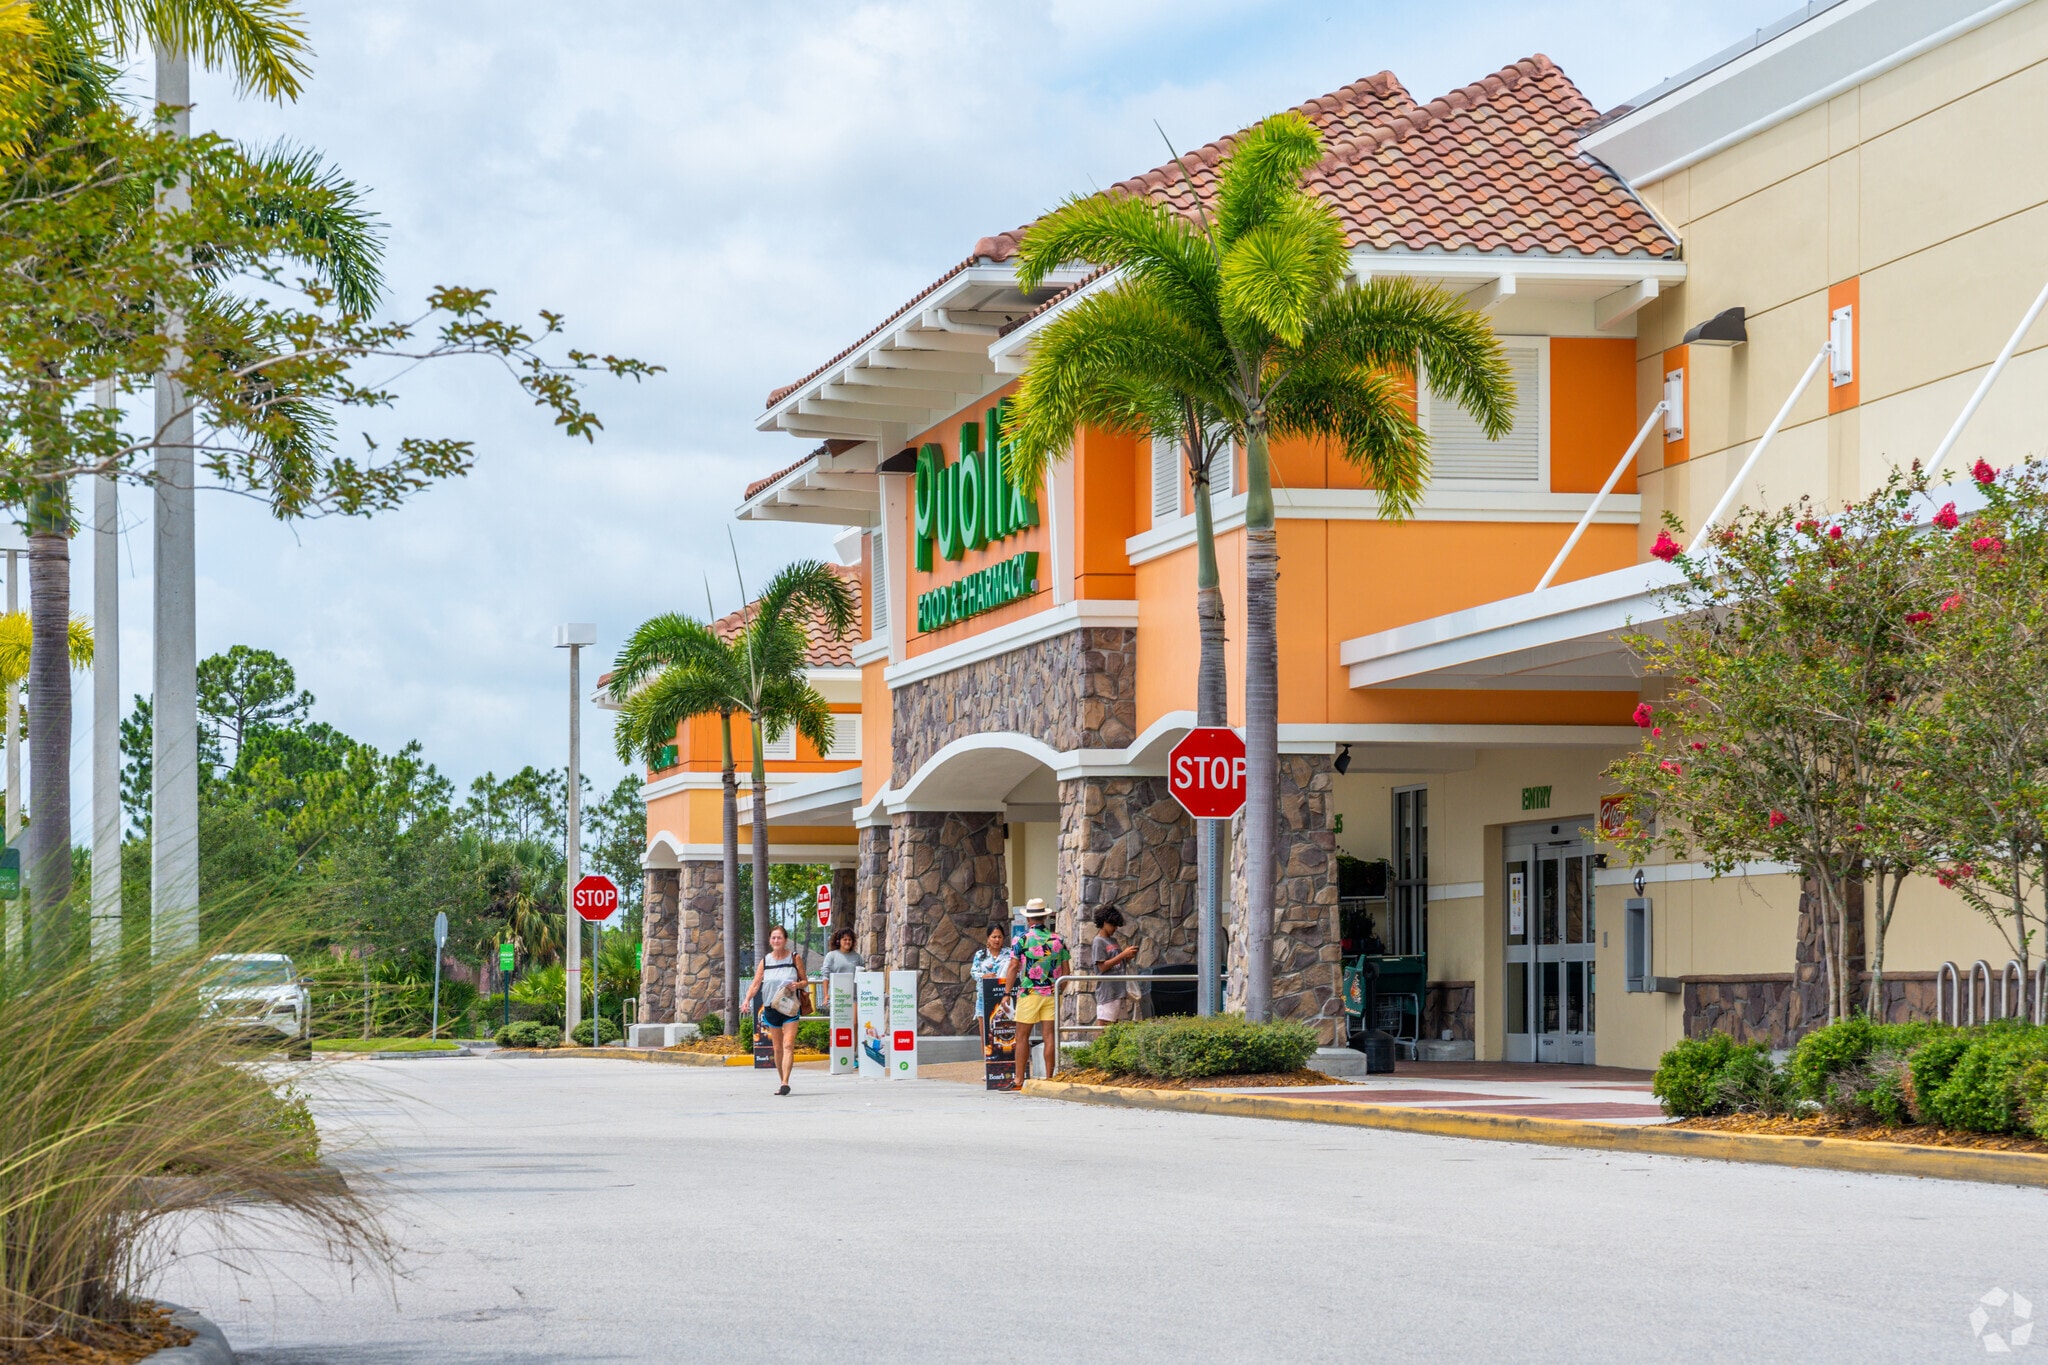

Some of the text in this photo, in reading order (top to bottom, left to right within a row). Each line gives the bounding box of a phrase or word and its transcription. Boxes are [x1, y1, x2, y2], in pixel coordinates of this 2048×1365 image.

[918, 551, 1030, 633] FOOD & PHARMACY
[1174, 755, 1247, 790] STOP
[1522, 785, 1552, 811] ENTRY
[576, 889, 616, 907] STOP
